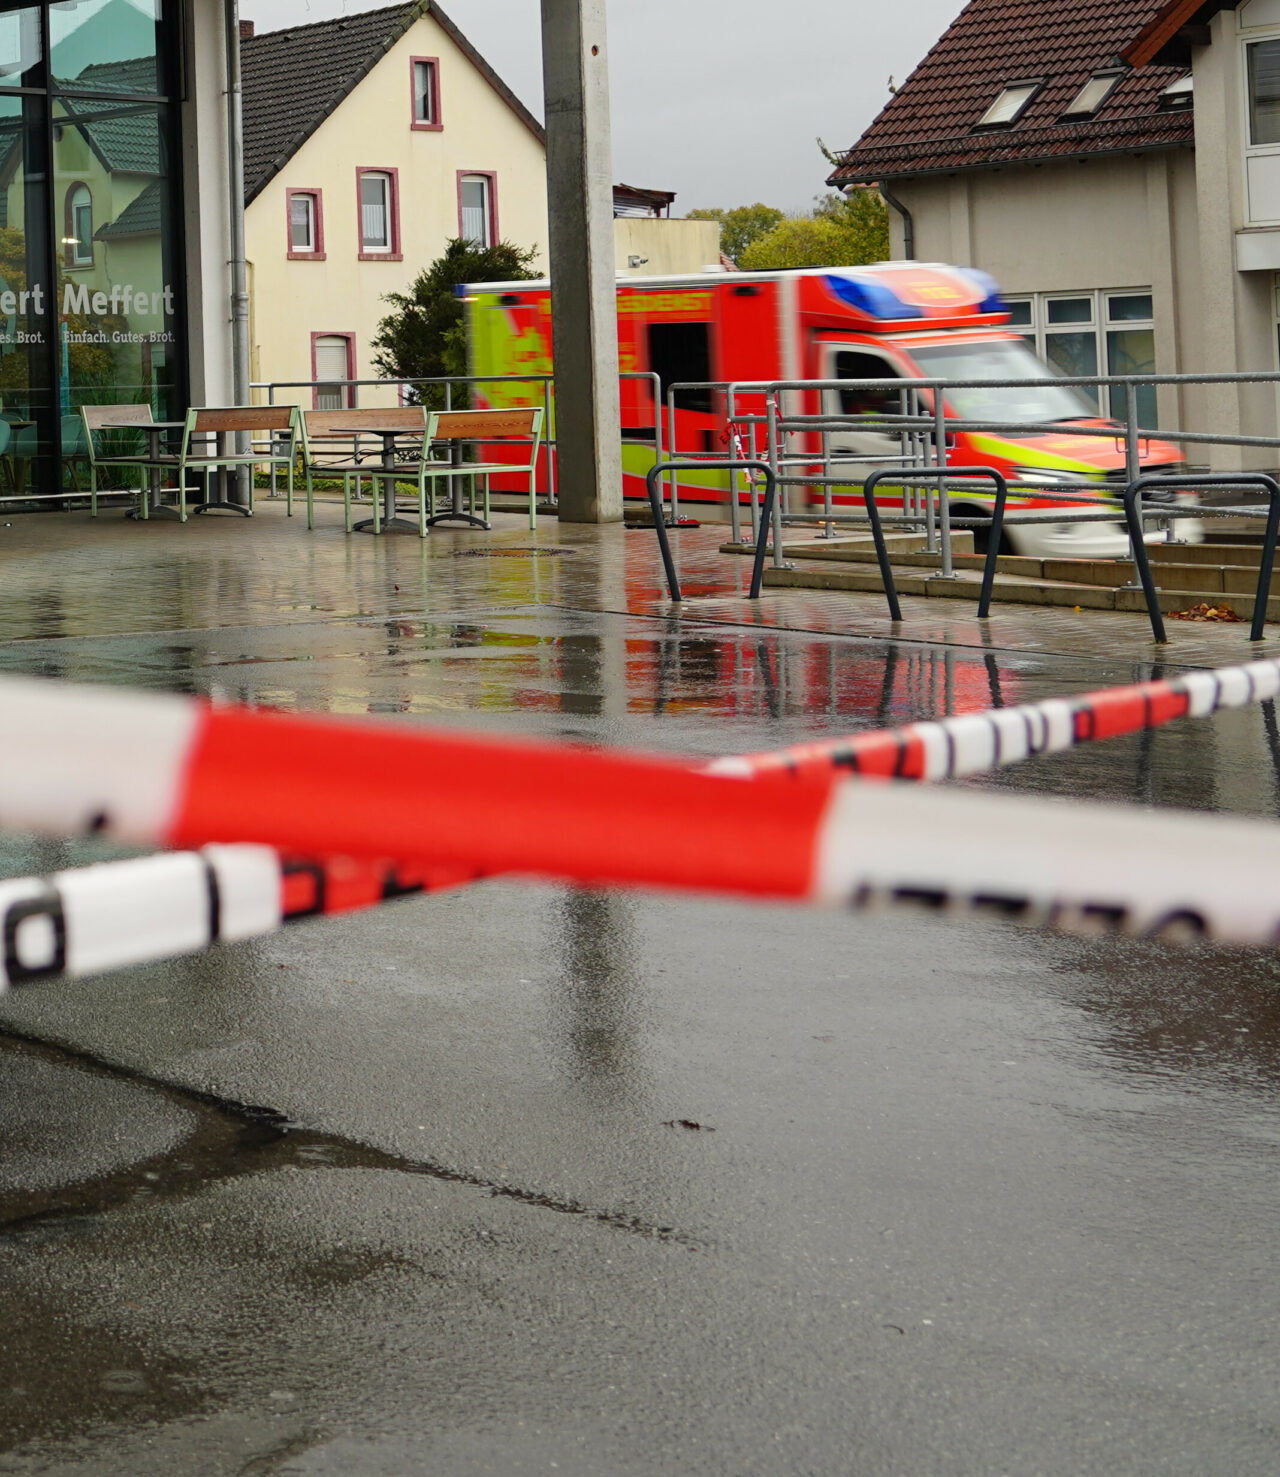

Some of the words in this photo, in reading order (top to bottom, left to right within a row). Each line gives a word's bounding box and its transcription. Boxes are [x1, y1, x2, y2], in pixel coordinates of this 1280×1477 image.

[62, 283, 175, 316] Meffert
[17, 331, 46, 344] Brot.
[63, 330, 110, 344] Einfach.
[112, 330, 147, 344] Gutes.
[149, 330, 176, 344] Brot.
